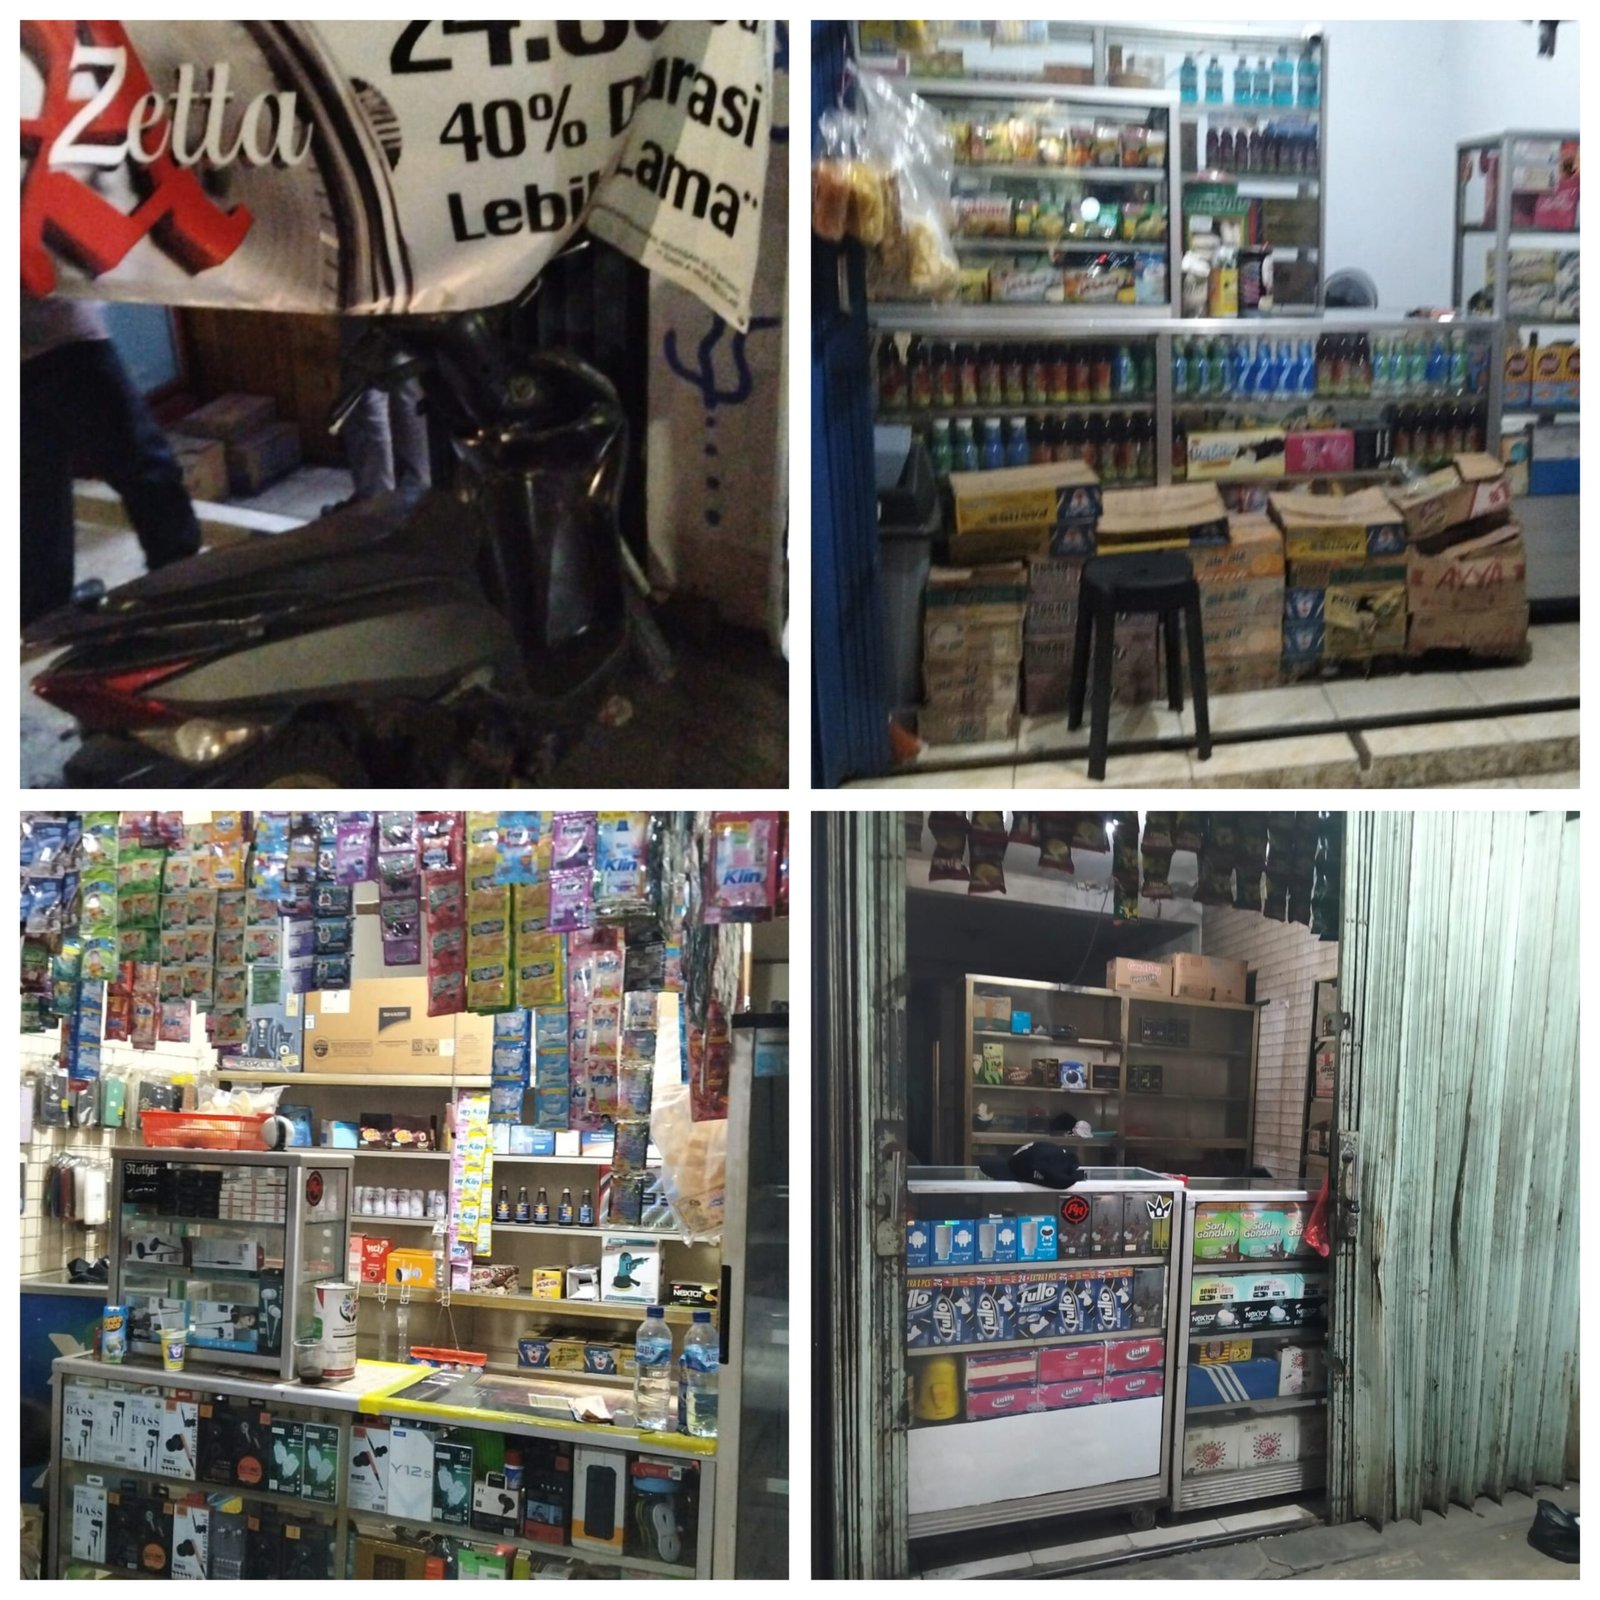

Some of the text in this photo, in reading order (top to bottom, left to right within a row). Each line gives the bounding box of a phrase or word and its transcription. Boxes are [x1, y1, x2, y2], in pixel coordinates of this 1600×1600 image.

[48, 45, 314, 167] Zetta
[439, 84, 588, 163] 40%
[605, 858, 638, 871] Klin
[723, 869, 762, 885] Klin
[1196, 1229, 1236, 1240] Gandum
[1243, 1229, 1282, 1239] Gandum
[1020, 1283, 1056, 1308] fullo
[976, 1300, 1000, 1331] fullo
[1058, 1295, 1079, 1324] fullo
[1097, 1293, 1117, 1321] fullo
[933, 1302, 957, 1334] fullo
[66, 1405, 94, 1417] BASS
[131, 1415, 160, 1427] BASS
[76, 1504, 103, 1518] BASS
